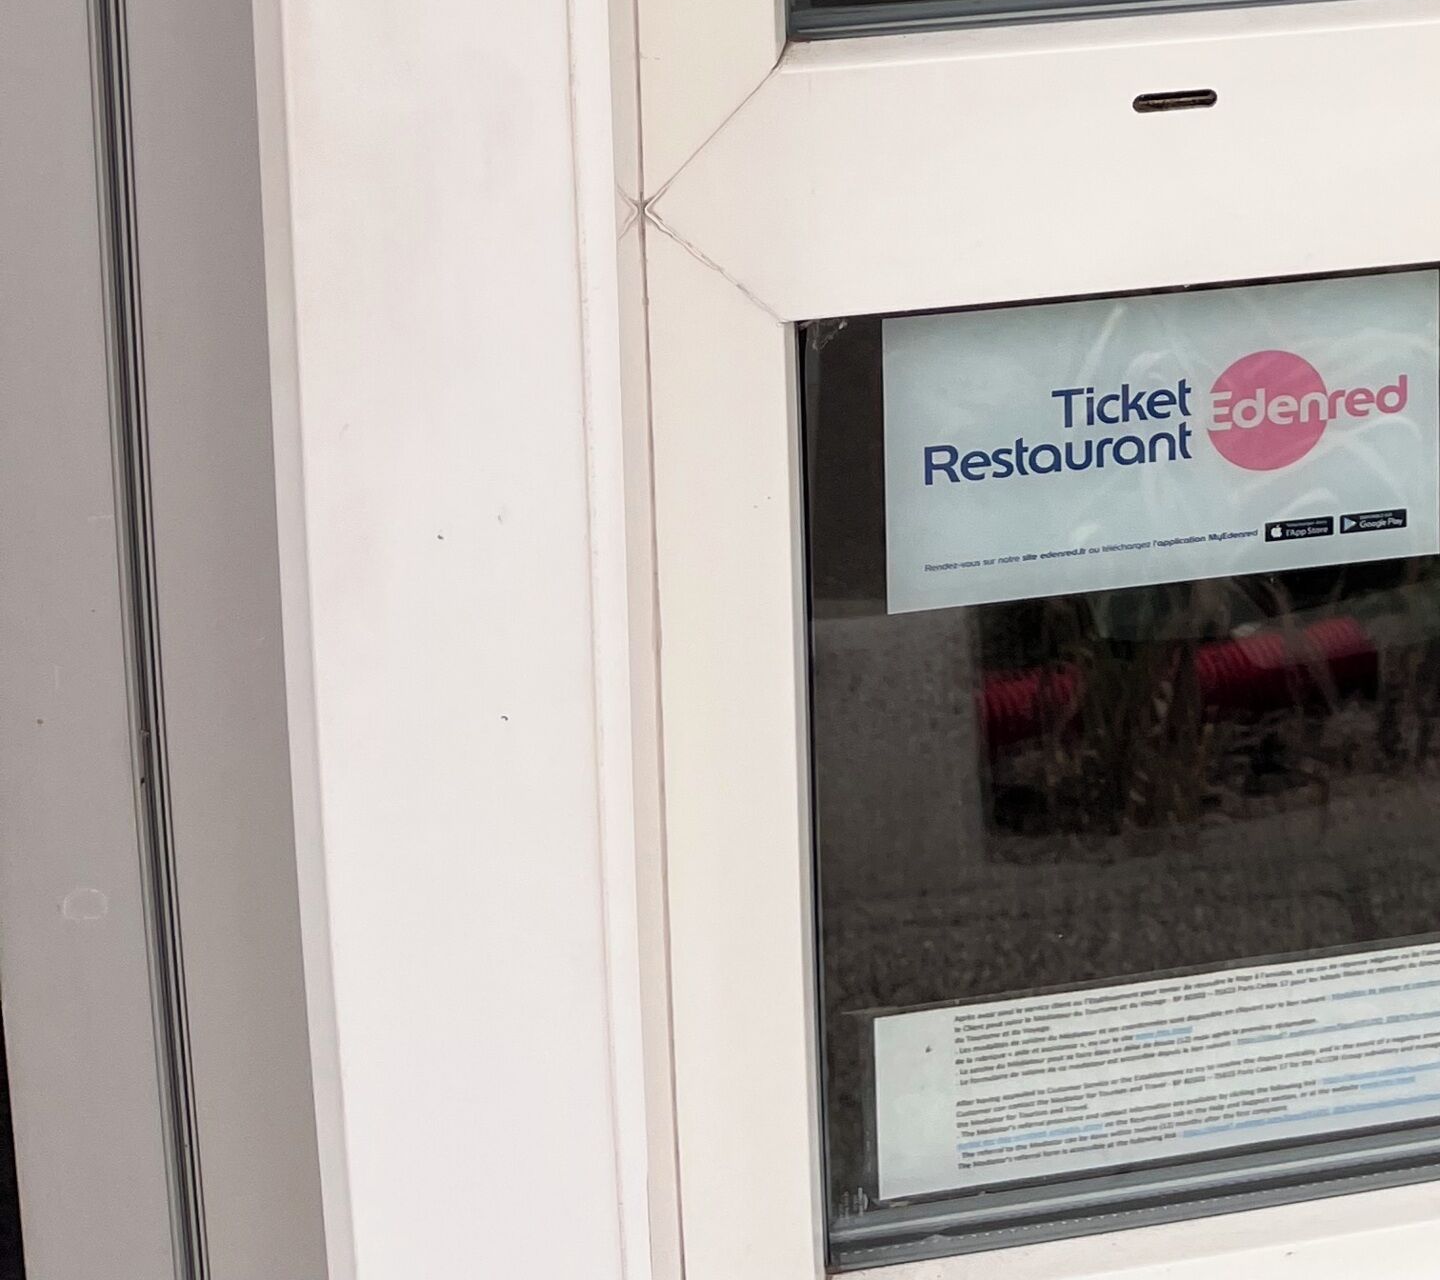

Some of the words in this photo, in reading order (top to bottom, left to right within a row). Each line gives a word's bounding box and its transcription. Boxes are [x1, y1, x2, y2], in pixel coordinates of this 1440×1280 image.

[1051, 378, 1193, 428] Ticket
[1208, 375, 1408, 431] Edenred
[923, 422, 1193, 486] Restaurant
